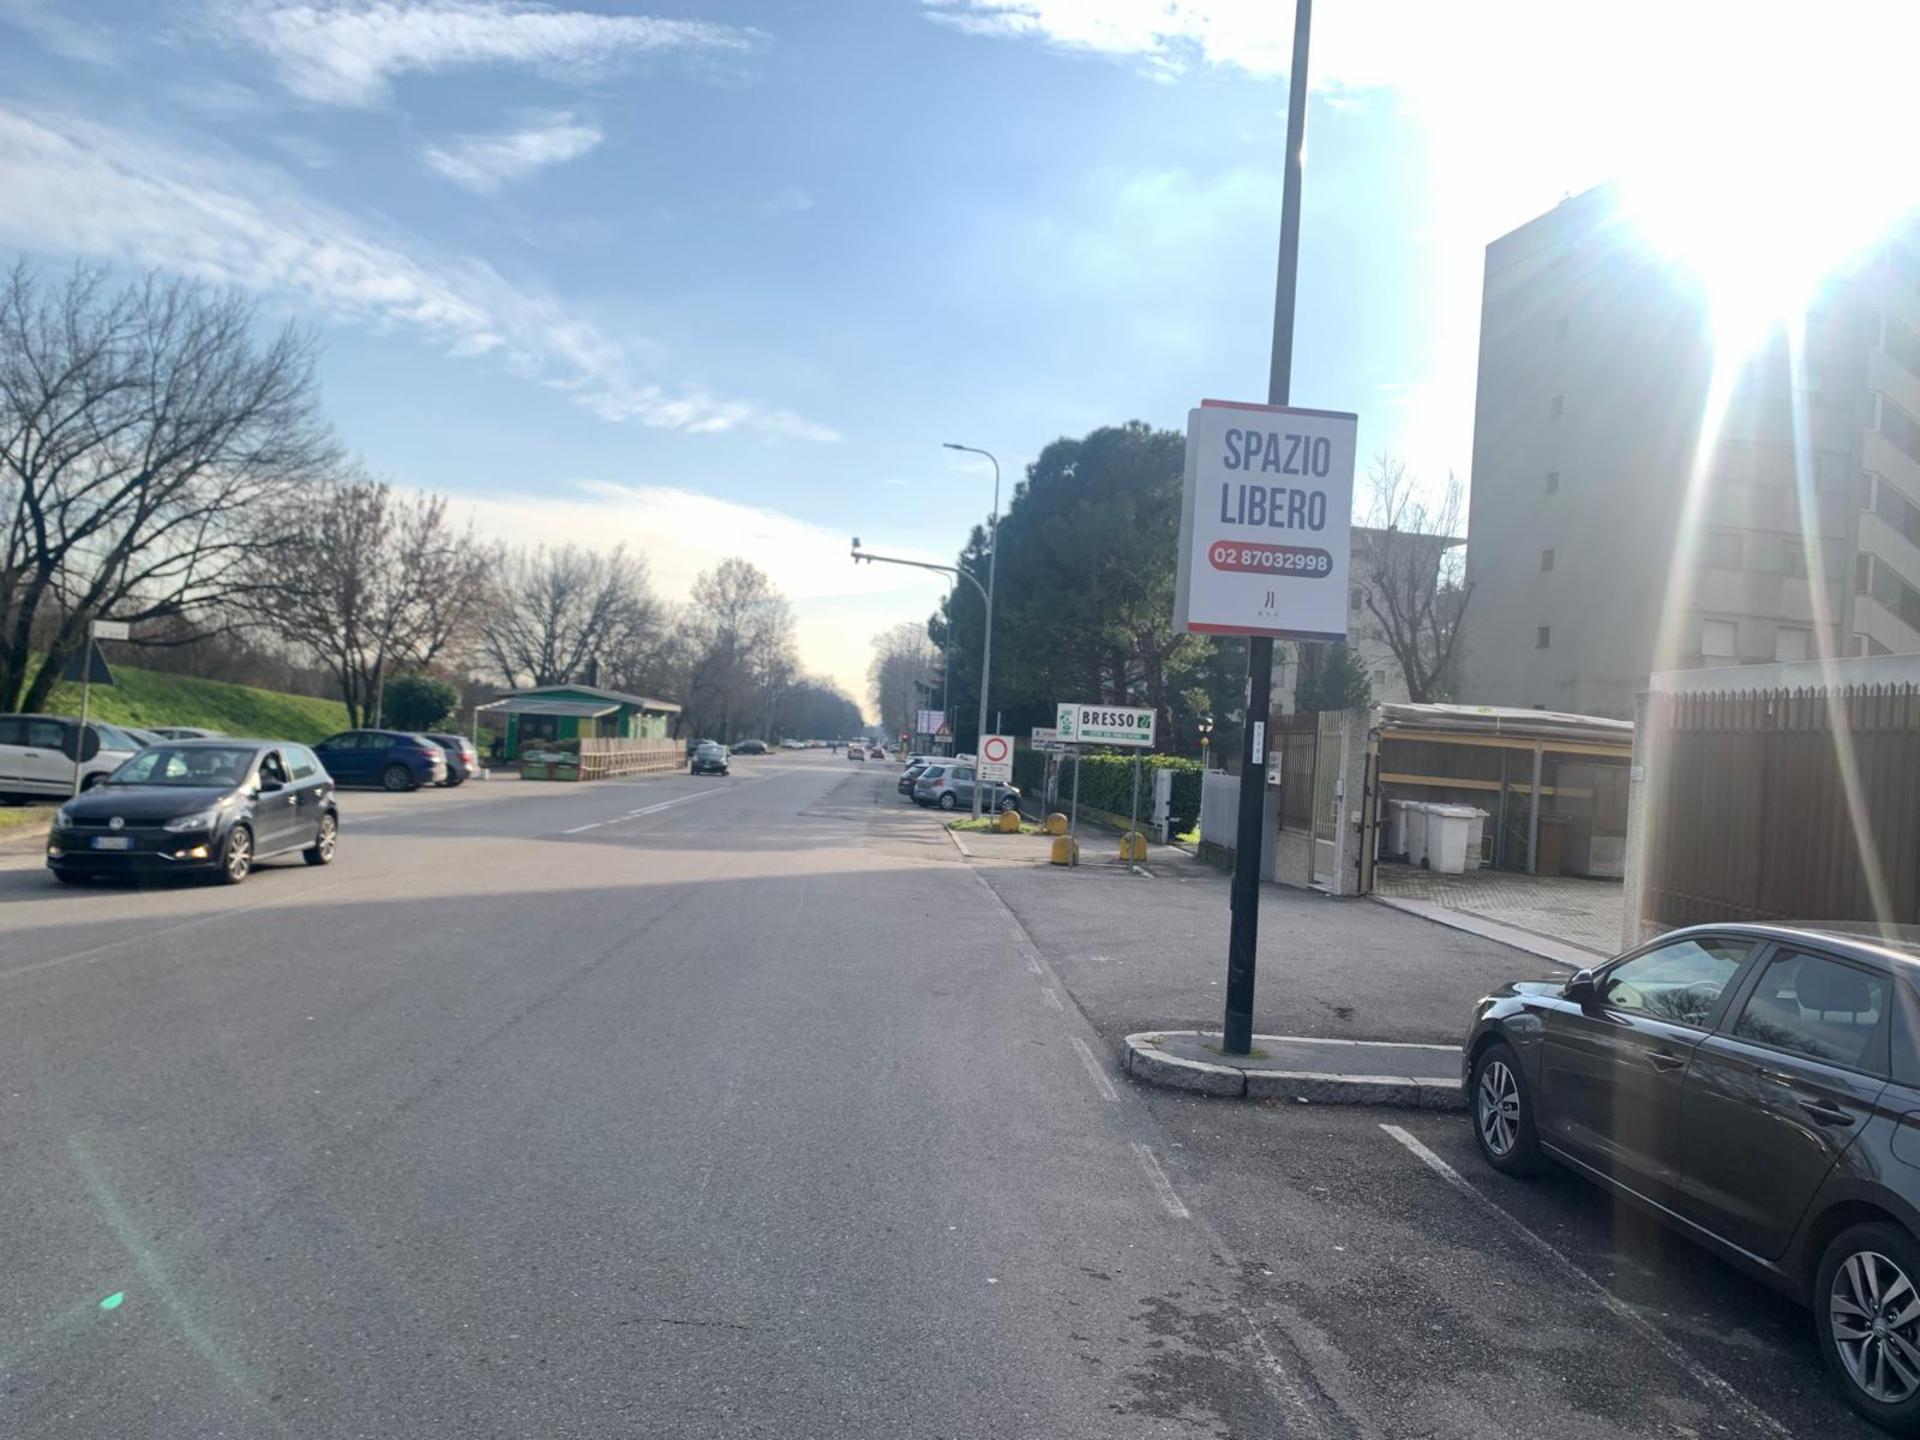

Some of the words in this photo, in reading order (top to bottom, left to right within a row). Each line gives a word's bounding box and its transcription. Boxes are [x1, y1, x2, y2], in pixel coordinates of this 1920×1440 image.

[1223, 428, 1331, 477] SPAZIO
[1220, 483, 1327, 531] LIBERO
[1214, 548, 1236, 564] 02
[1241, 550, 1327, 571] 87032998
[1082, 711, 1134, 727] BRESSO
